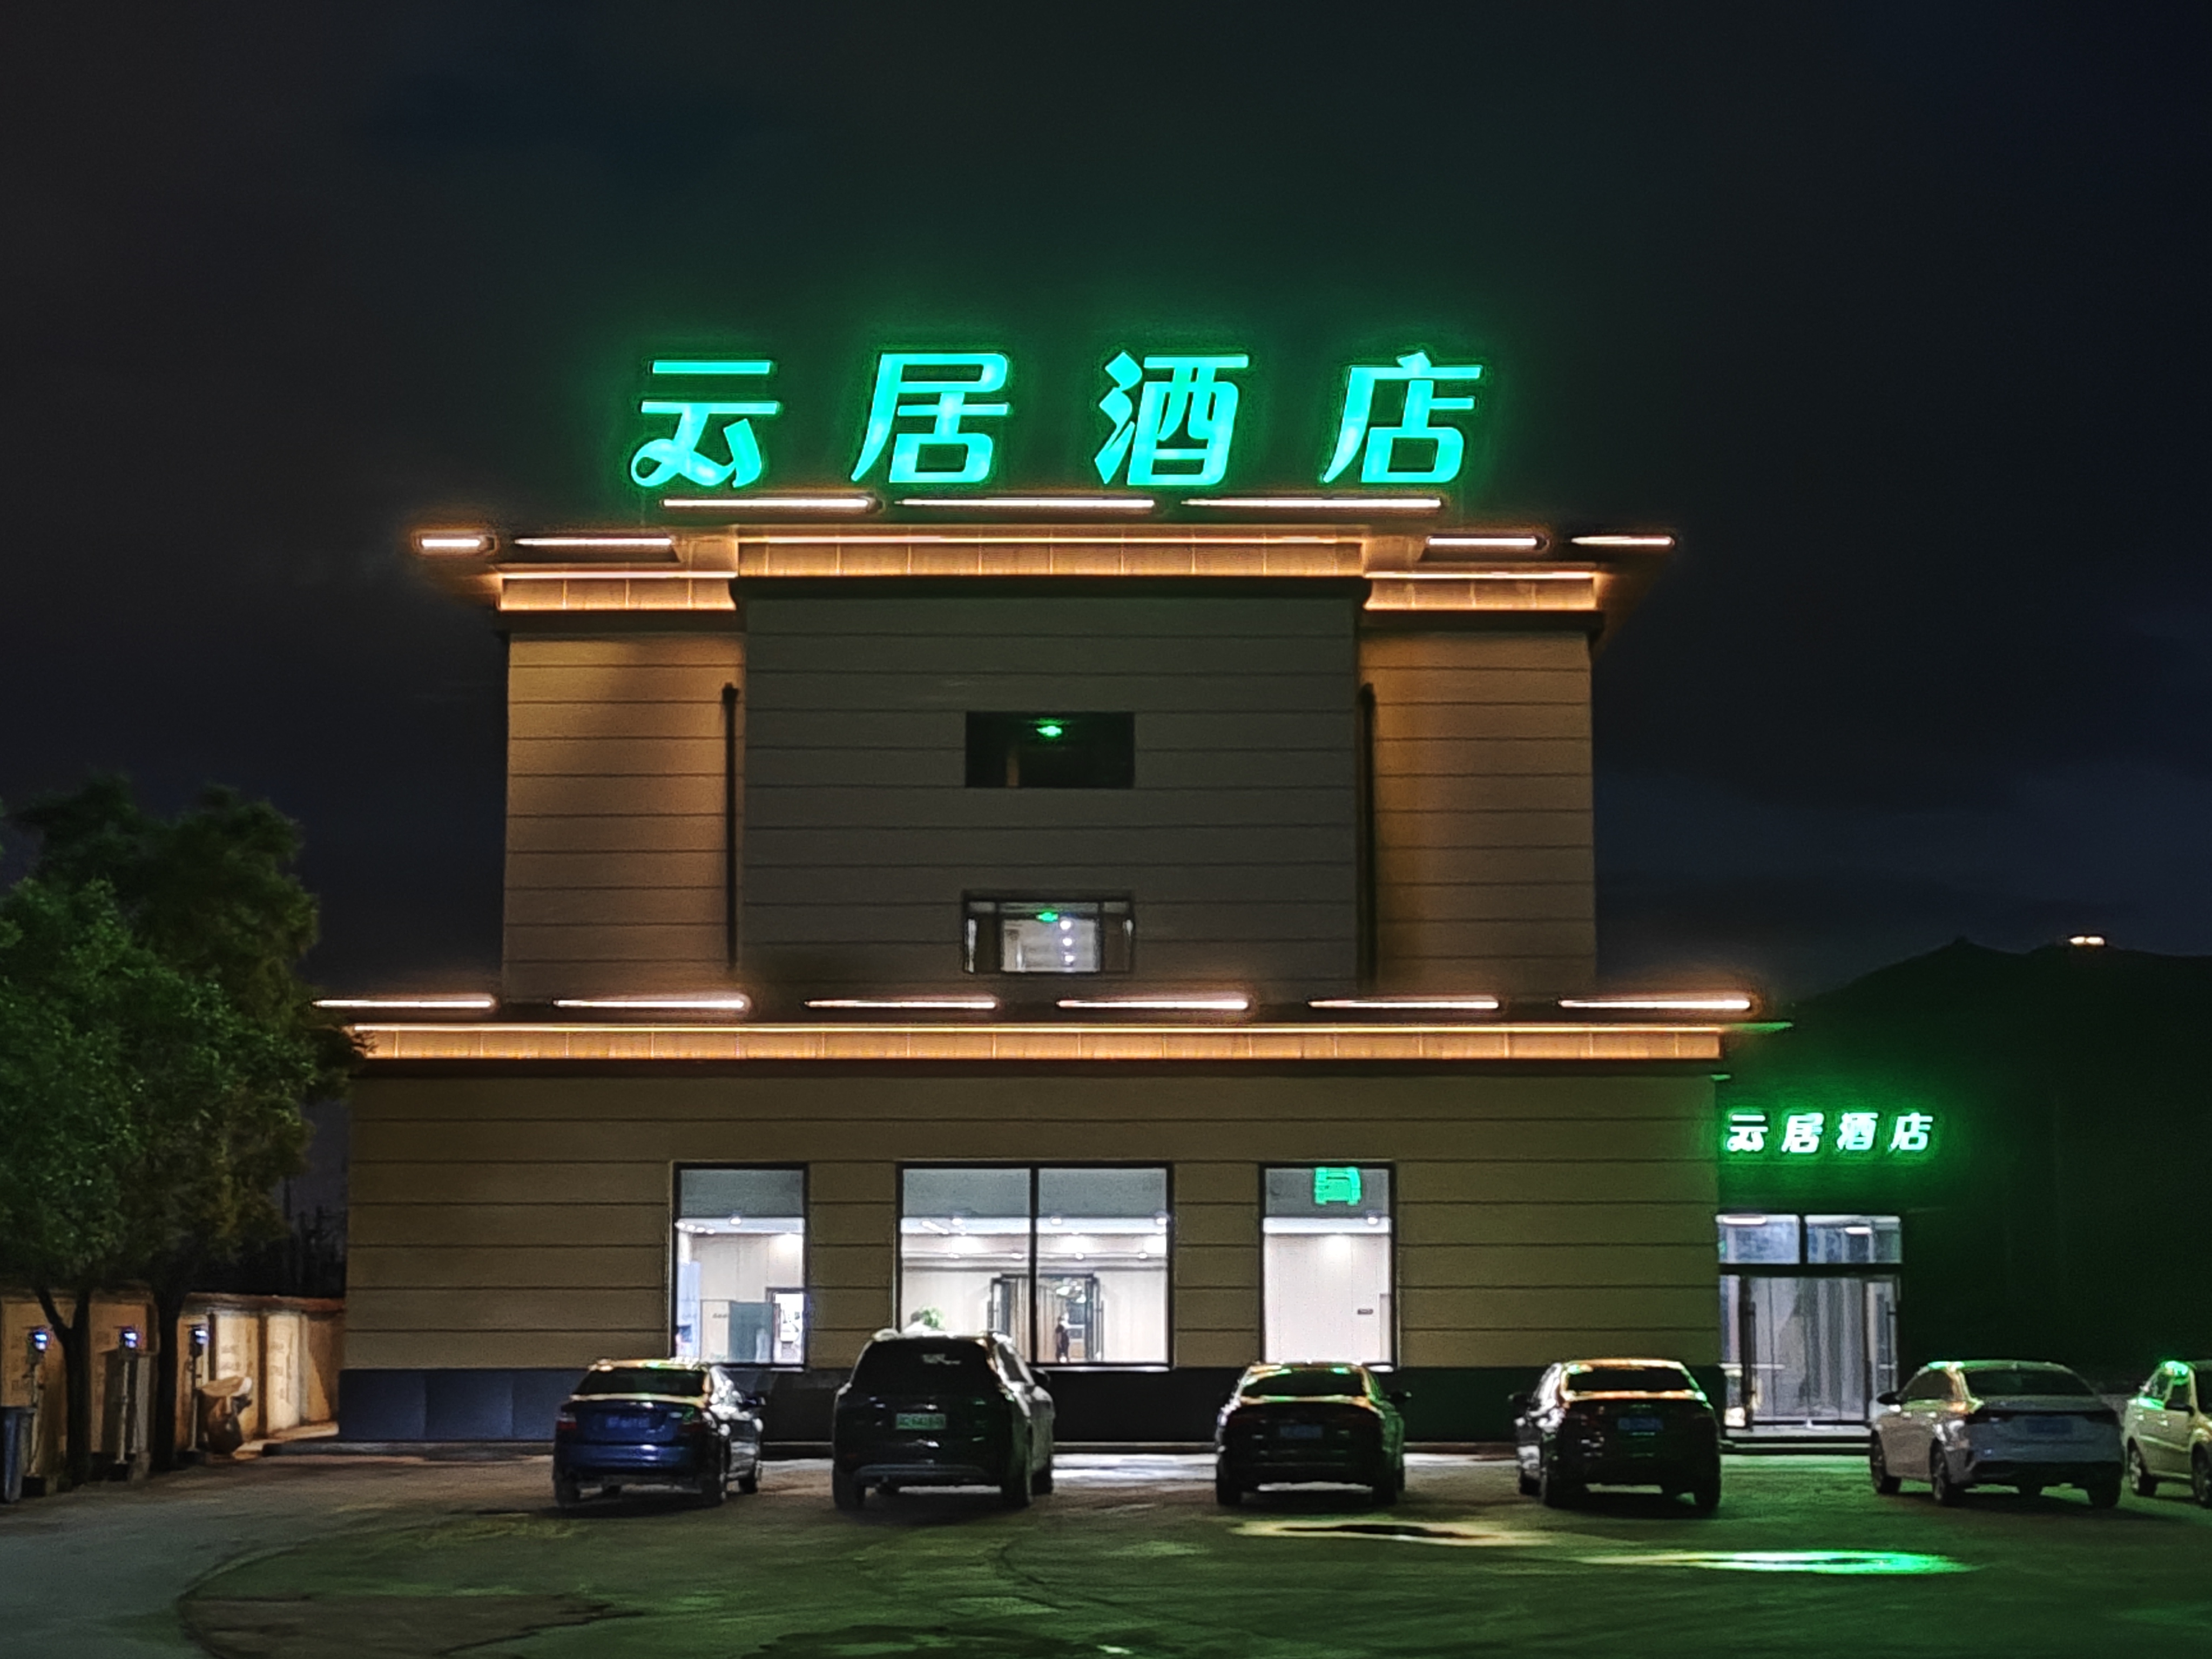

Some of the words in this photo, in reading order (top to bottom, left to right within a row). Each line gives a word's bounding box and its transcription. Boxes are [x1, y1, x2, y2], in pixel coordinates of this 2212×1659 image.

[629, 351, 1483, 488] 云居酒店
[1726, 1111, 1933, 1154] 云居酒店
